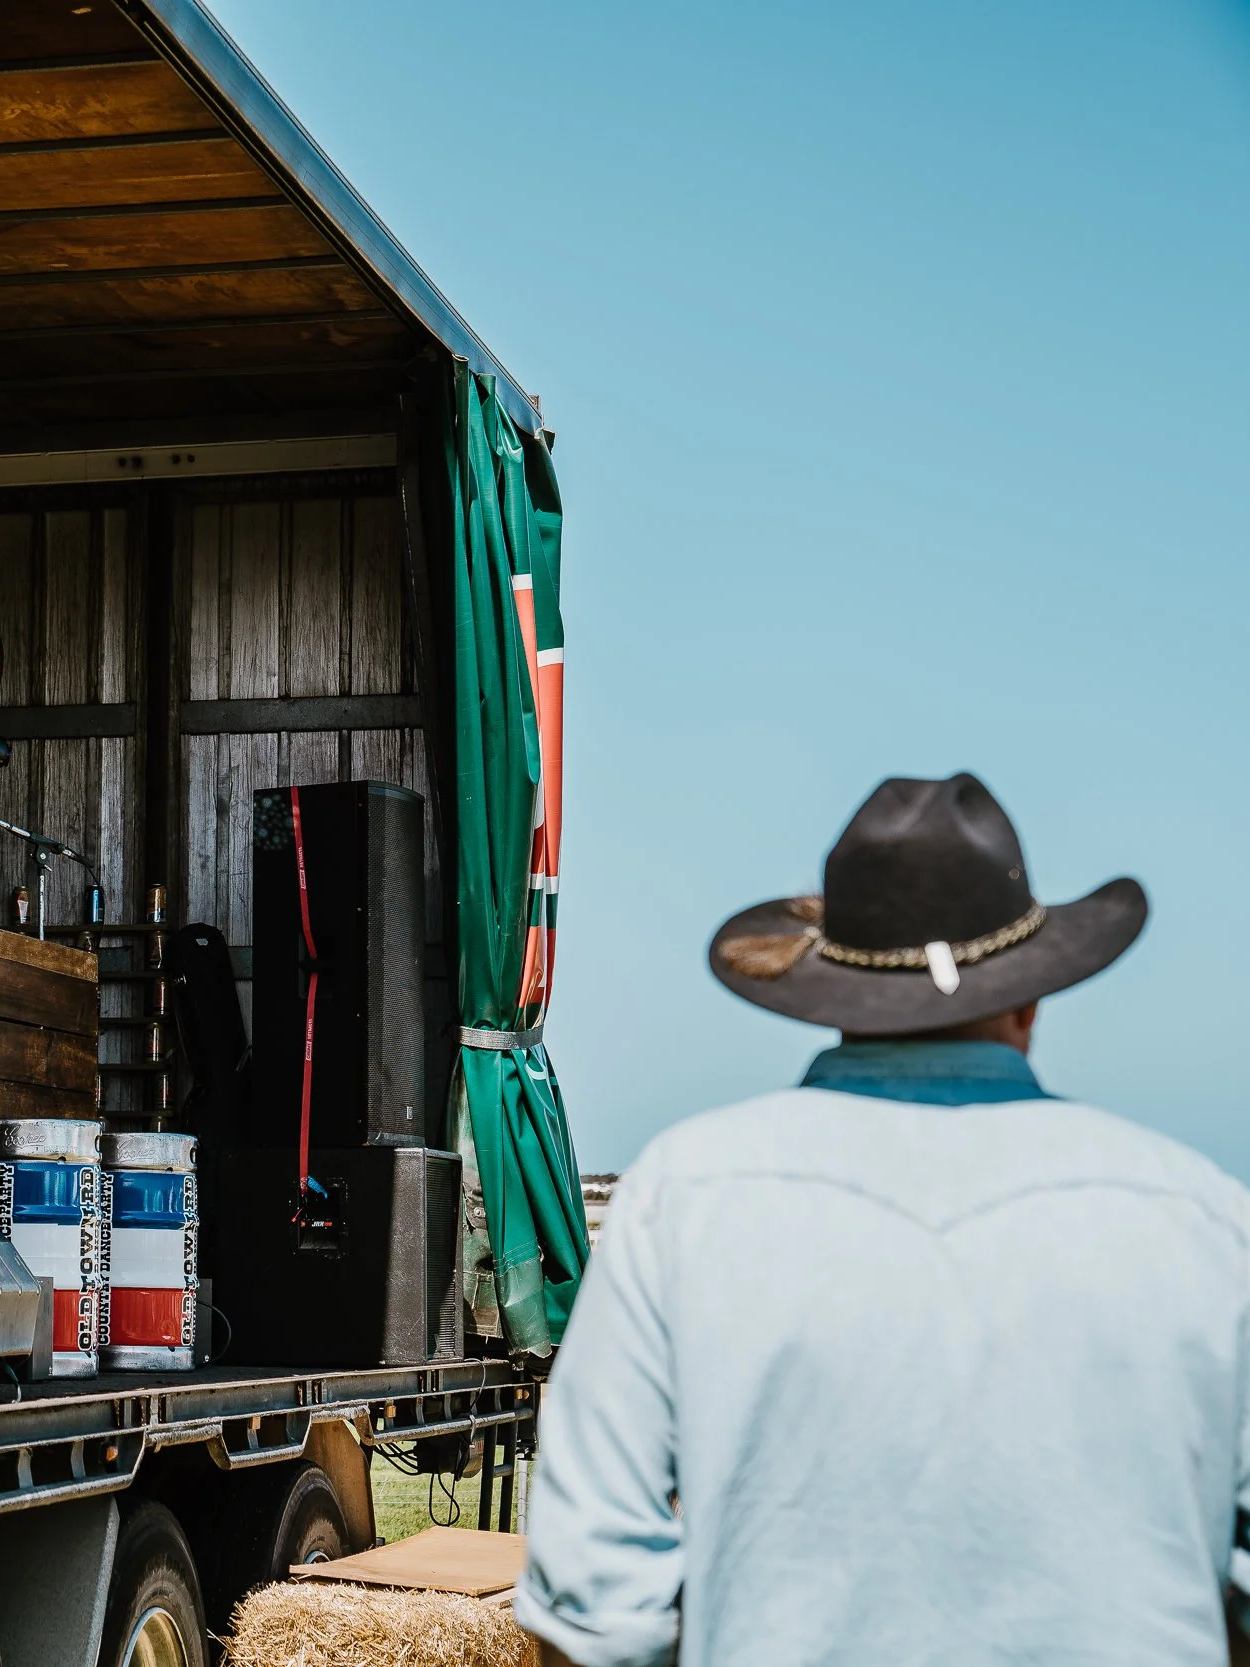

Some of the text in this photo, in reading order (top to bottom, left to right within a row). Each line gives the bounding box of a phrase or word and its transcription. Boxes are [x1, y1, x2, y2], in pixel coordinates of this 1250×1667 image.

[0, 1163, 14, 1215] PARTY
[184, 1178, 194, 1209] RD
[79, 1169, 96, 1350] OLD TOWN RD
[99, 1173, 113, 1345] COUNTRY DANCE PARTY
[183, 1213, 196, 1293] TOWN
[182, 1296, 193, 1345] OLD
